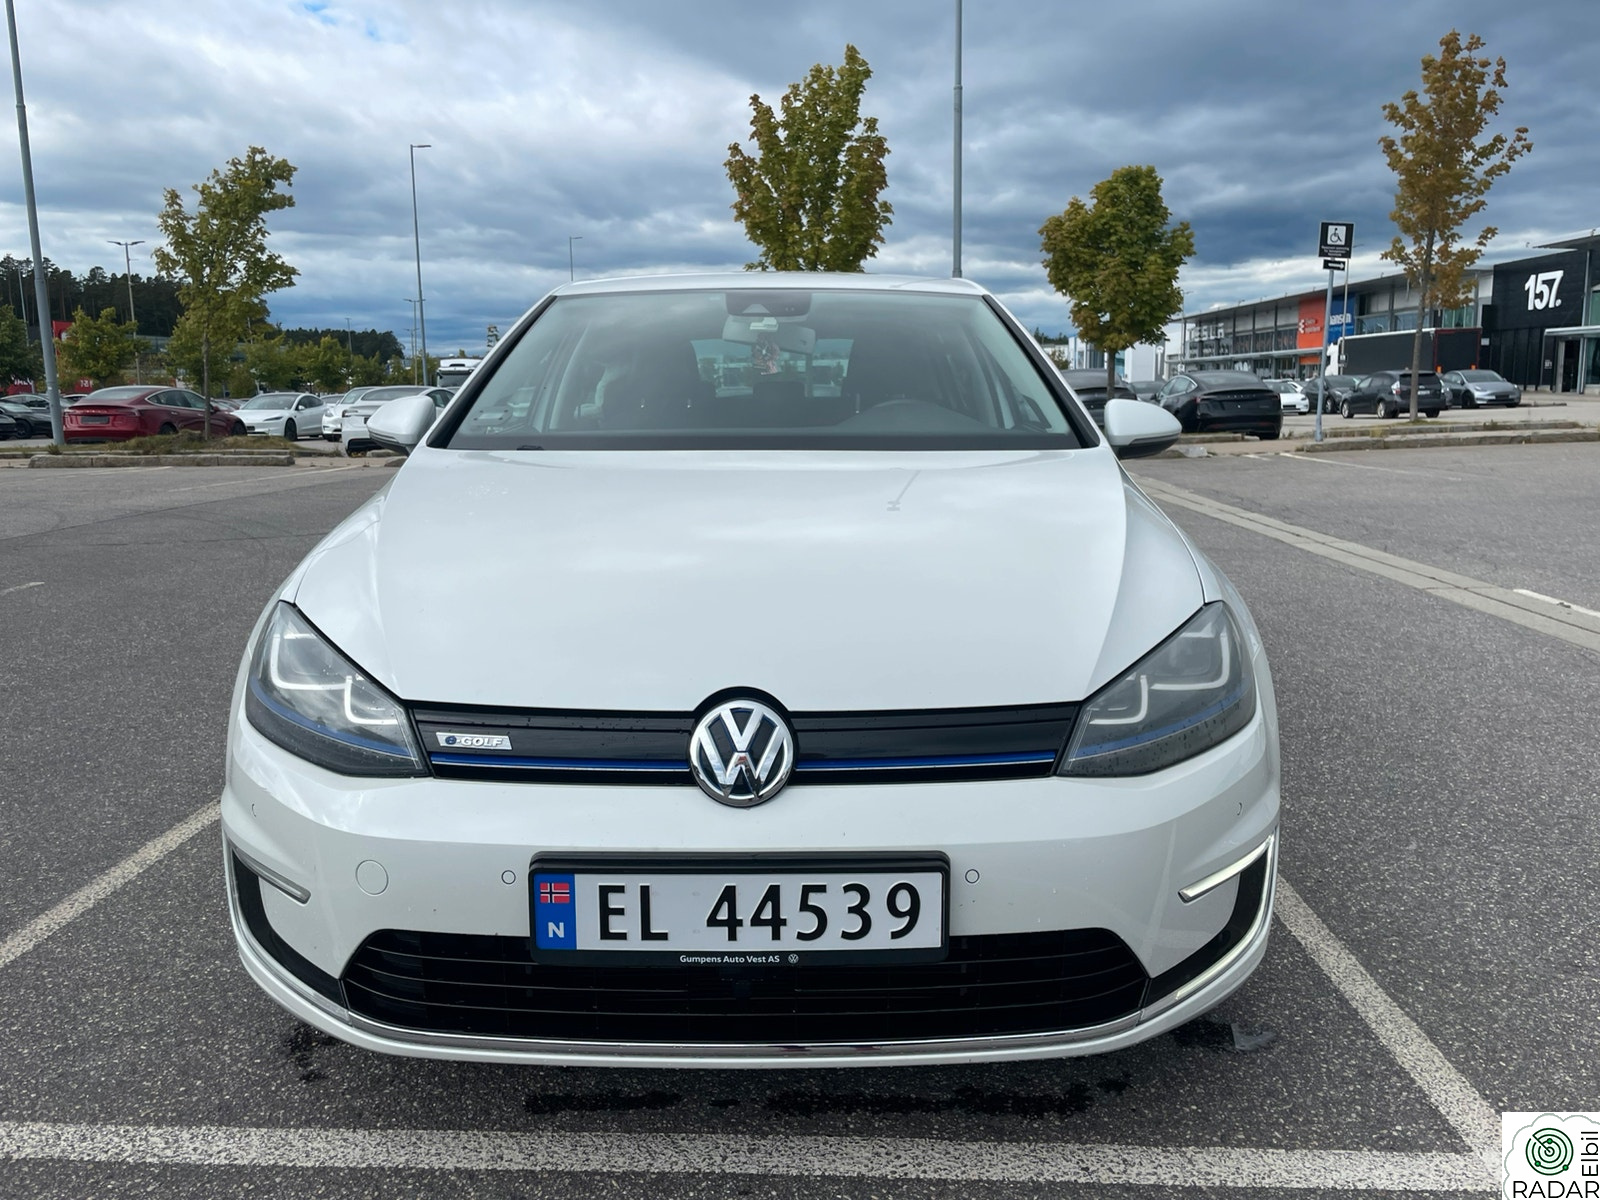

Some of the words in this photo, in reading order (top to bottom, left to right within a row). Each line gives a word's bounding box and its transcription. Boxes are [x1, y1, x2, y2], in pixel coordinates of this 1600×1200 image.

[1186, 323, 1224, 342] TESLA
[598, 884, 669, 941] EL
[705, 881, 921, 942] 44539
[548, 922, 565, 939] N
[679, 955, 722, 965] Gumpens
[723, 955, 745, 963] Auto
[746, 955, 767, 963] Vest
[767, 955, 780, 963] AS
